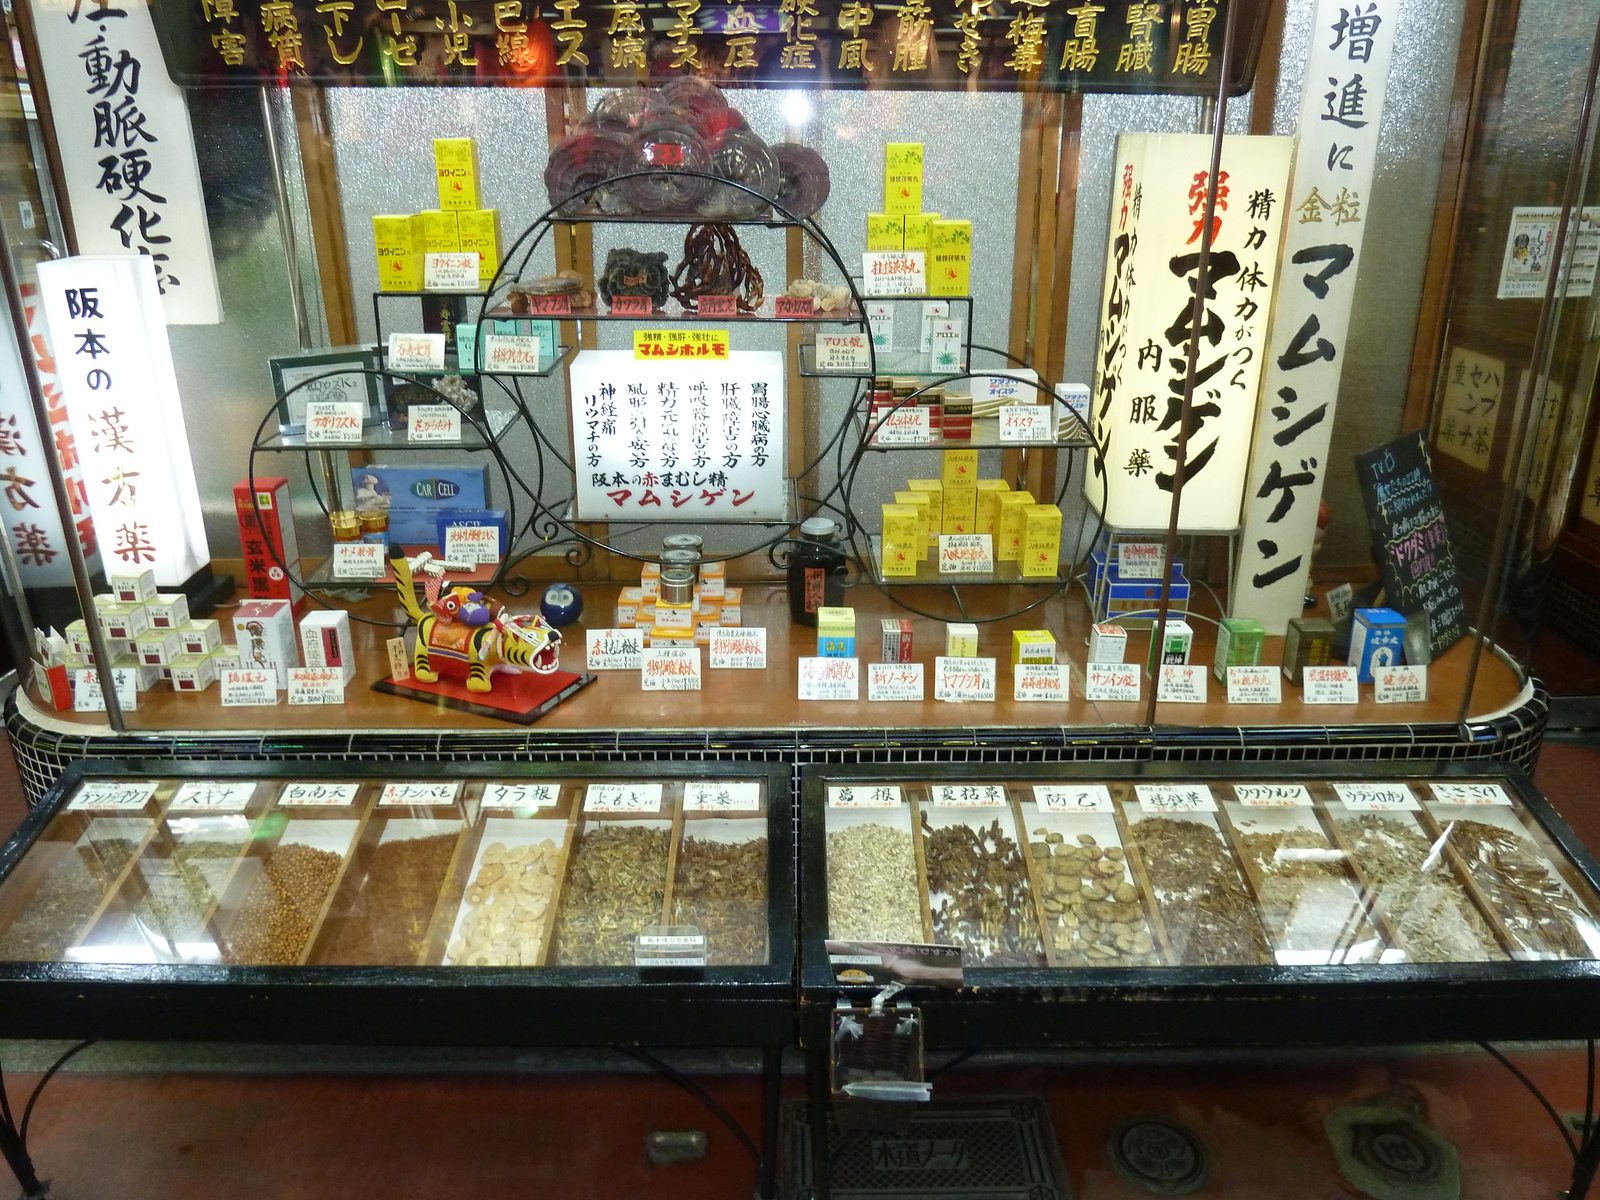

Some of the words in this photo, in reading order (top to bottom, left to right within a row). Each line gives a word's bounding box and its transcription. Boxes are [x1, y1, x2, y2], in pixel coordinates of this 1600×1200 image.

[837, 2, 874, 71] 中風
[1320, 2, 1382, 171] 増進に
[1229, 188, 1277, 390] 精力体力がつく
[638, 343, 726, 357] マムシホルモ
[64, 287, 157, 565] 阪本の漢方薬
[1252, 243, 1354, 589] マムシゲン
[416, 482, 433, 497] CAR
[438, 482, 456, 496] CELL
[592, 471, 728, 488] 阪本の赤まむし精
[606, 488, 755, 508] マムシゲン
[245, 539, 270, 599] 玄米黒
[181, 788, 235, 805] スギナ
[494, 785, 553, 802] タラ根
[593, 791, 645, 808] よもぎ
